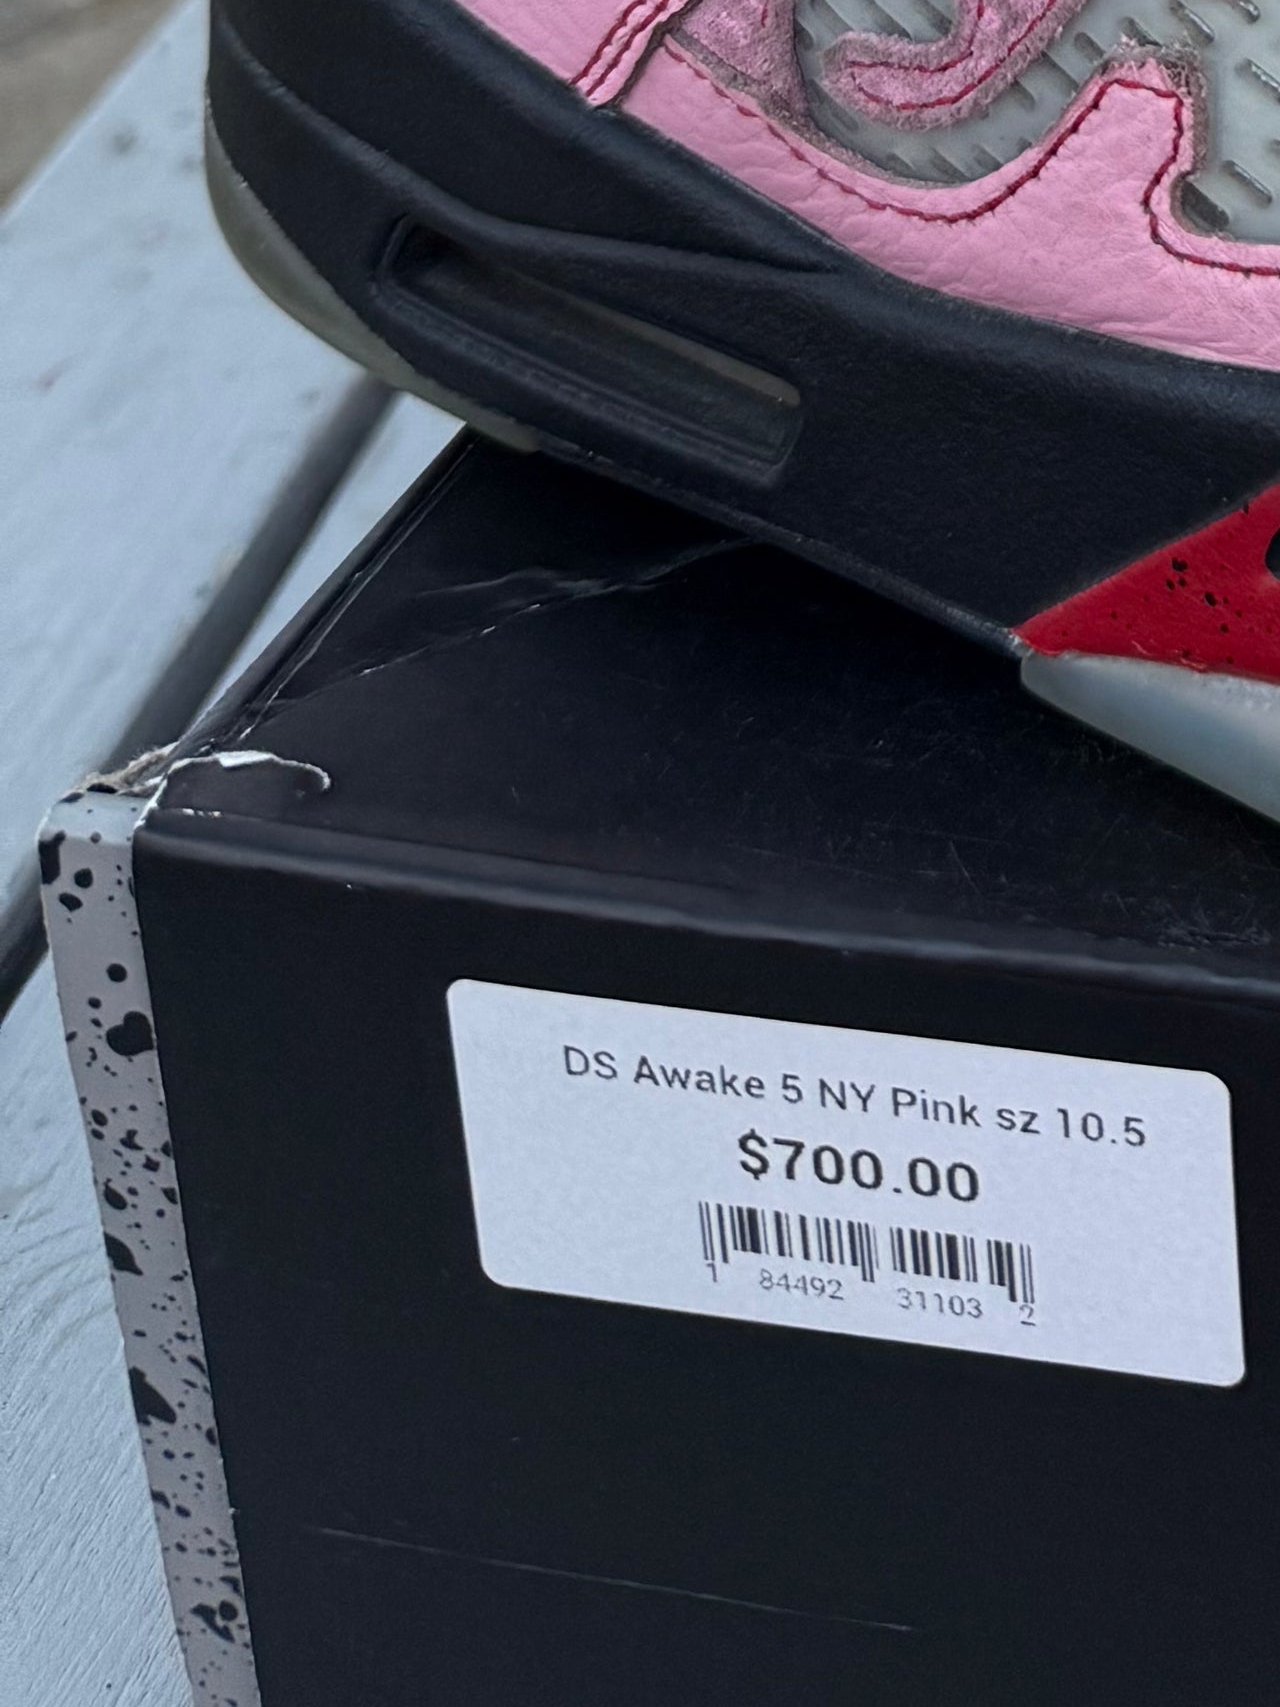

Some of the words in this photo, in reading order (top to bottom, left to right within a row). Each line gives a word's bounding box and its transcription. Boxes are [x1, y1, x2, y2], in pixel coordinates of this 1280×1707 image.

[563, 1044, 618, 1080] DS
[633, 1054, 766, 1100] Awake
[781, 1072, 804, 1105] 5
[819, 1077, 876, 1112] NY
[891, 1086, 982, 1128] Pink
[995, 1107, 1041, 1135] sz
[1057, 1107, 1147, 1148] 10.5
[737, 1127, 981, 1203] $700.00
[705, 1262, 718, 1284] 1
[758, 1268, 845, 1302] 84492
[896, 1287, 984, 1320] 31103
[1019, 1303, 1037, 1327] 2
